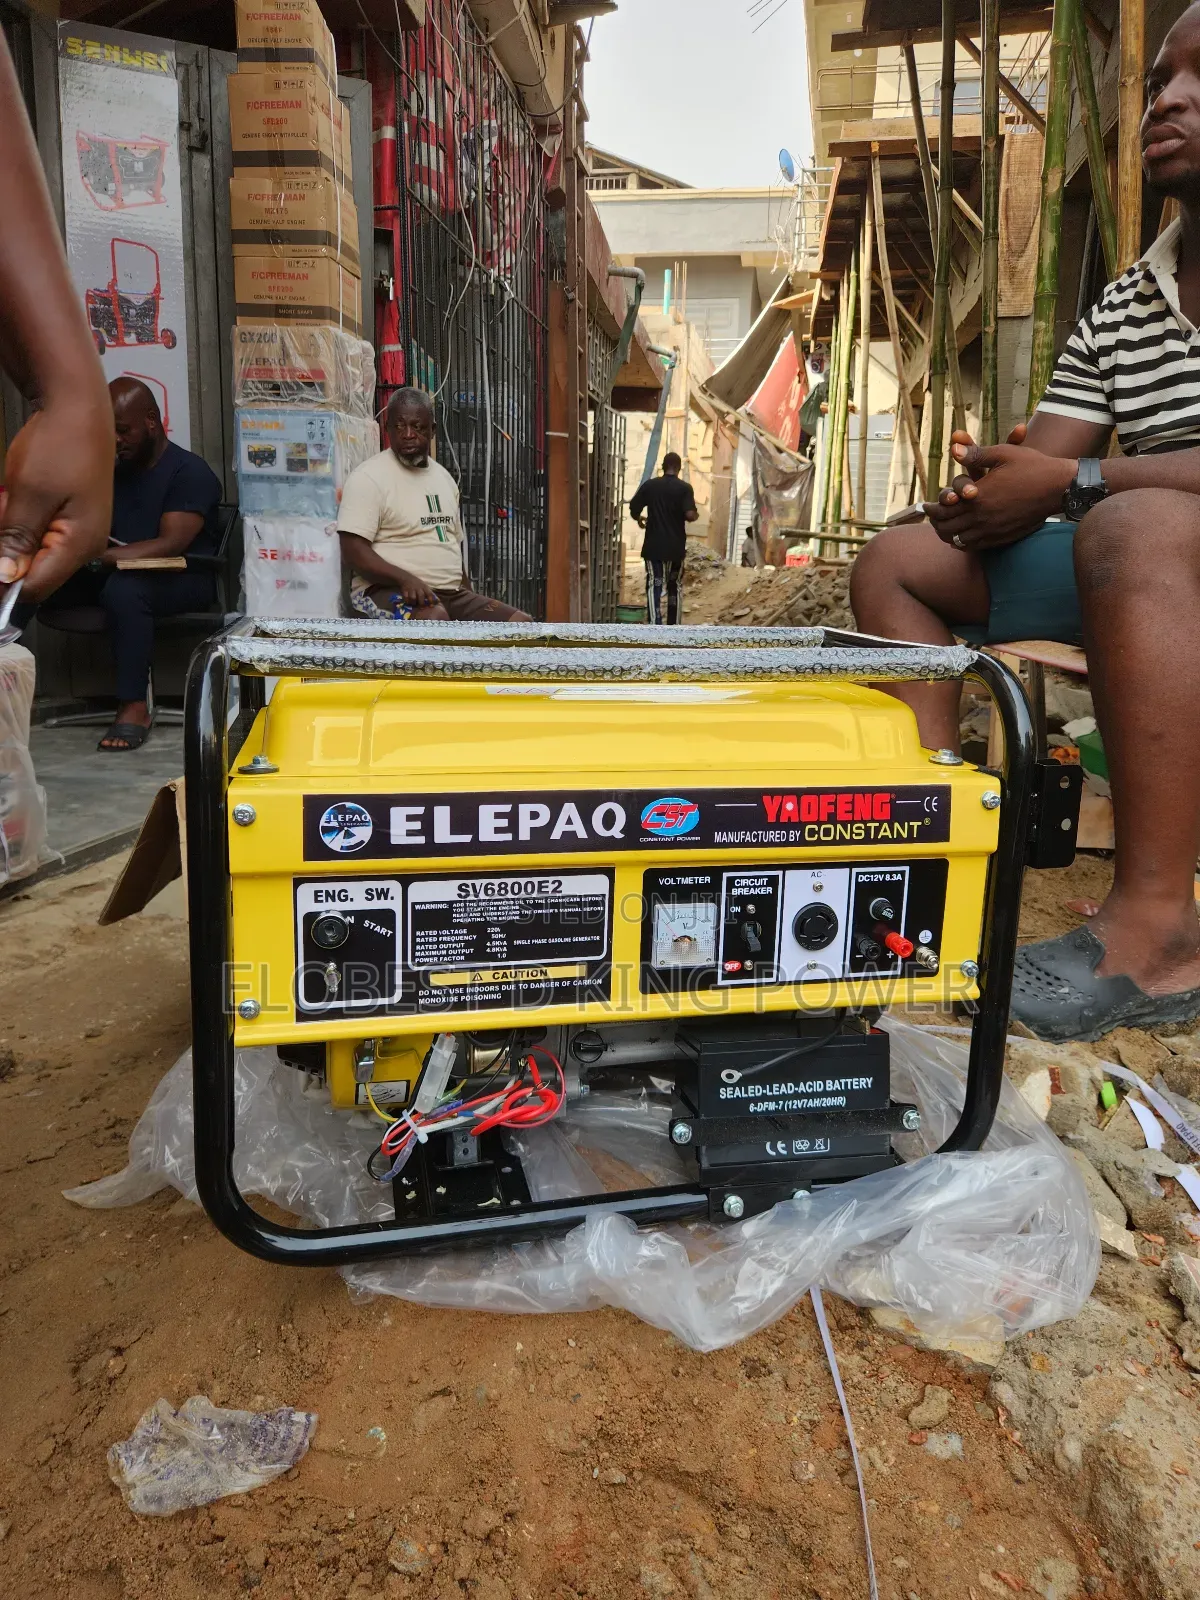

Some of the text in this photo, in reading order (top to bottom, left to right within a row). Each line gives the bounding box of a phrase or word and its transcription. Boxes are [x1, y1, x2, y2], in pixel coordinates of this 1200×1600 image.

[246, 12, 301, 21] F/CFREEMAN
[66, 37, 168, 72] SENWEI
[246, 100, 302, 110] F/CFREEMAN
[252, 272, 308, 280] F/CFREEMAN
[240, 330, 278, 344] GX200
[762, 793, 890, 823] YAOFENG
[324, 814, 370, 822] ELEPAQ
[641, 802, 698, 829] CST
[390, 802, 626, 844] ELEPAQ
[714, 822, 922, 843] MANUFACTURED BY CONSTANT
[659, 876, 711, 886] VOLTMETER
[734, 878, 768, 887] CIRCUIT
[858, 874, 884, 882] DC12V
[314, 888, 394, 904] ENG. SW.
[457, 880, 562, 900] SV6800E2
[732, 887, 773, 896] BREAKER
[363, 920, 394, 938] START
[492, 969, 548, 980] CAUTION
[419, 993, 502, 1005] MONOXIDE POISONING
[720, 1077, 873, 1099] SEALED-LEAD-ACID BATTERY
[749, 1096, 846, 1112] 6-DFM-7 (12V7AH/20HR)
